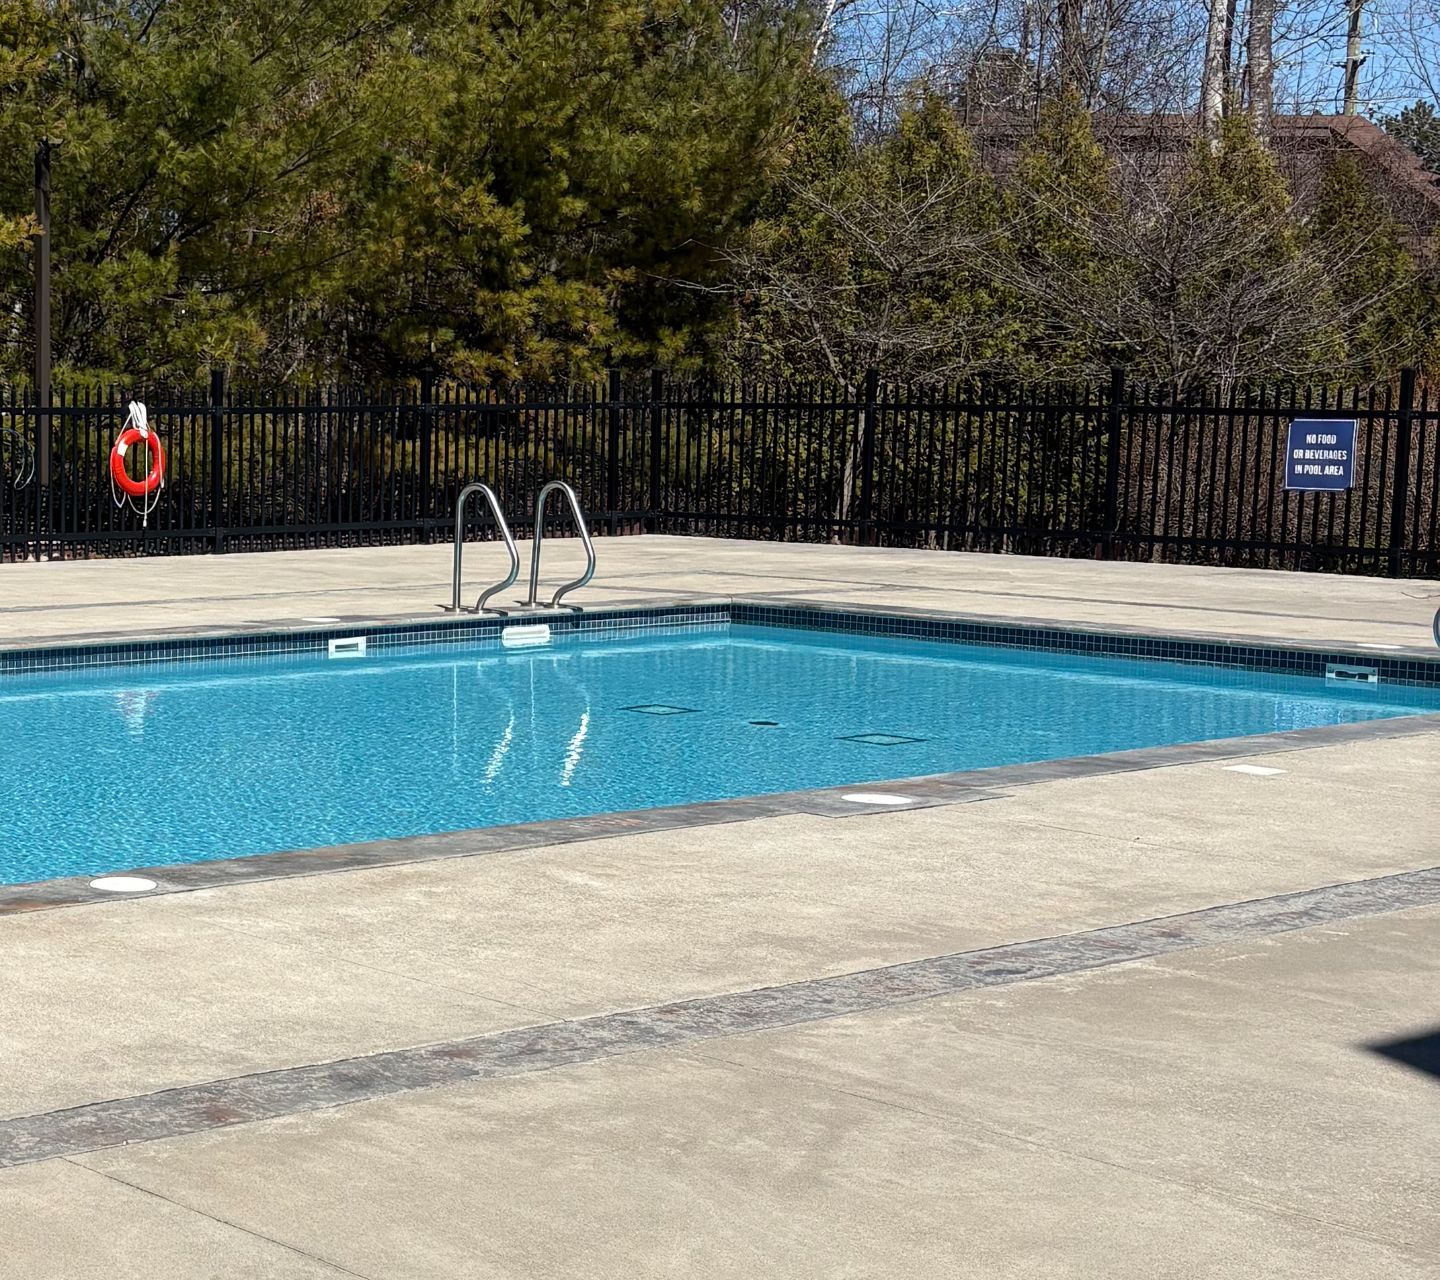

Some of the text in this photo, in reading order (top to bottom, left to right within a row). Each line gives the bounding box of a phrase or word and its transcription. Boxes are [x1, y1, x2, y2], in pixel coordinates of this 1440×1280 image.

[1306, 434, 1337, 444] NO FOOD
[1293, 450, 1347, 460] OR BEVERAGES
[1295, 465, 1343, 475] IN POOL AREA
